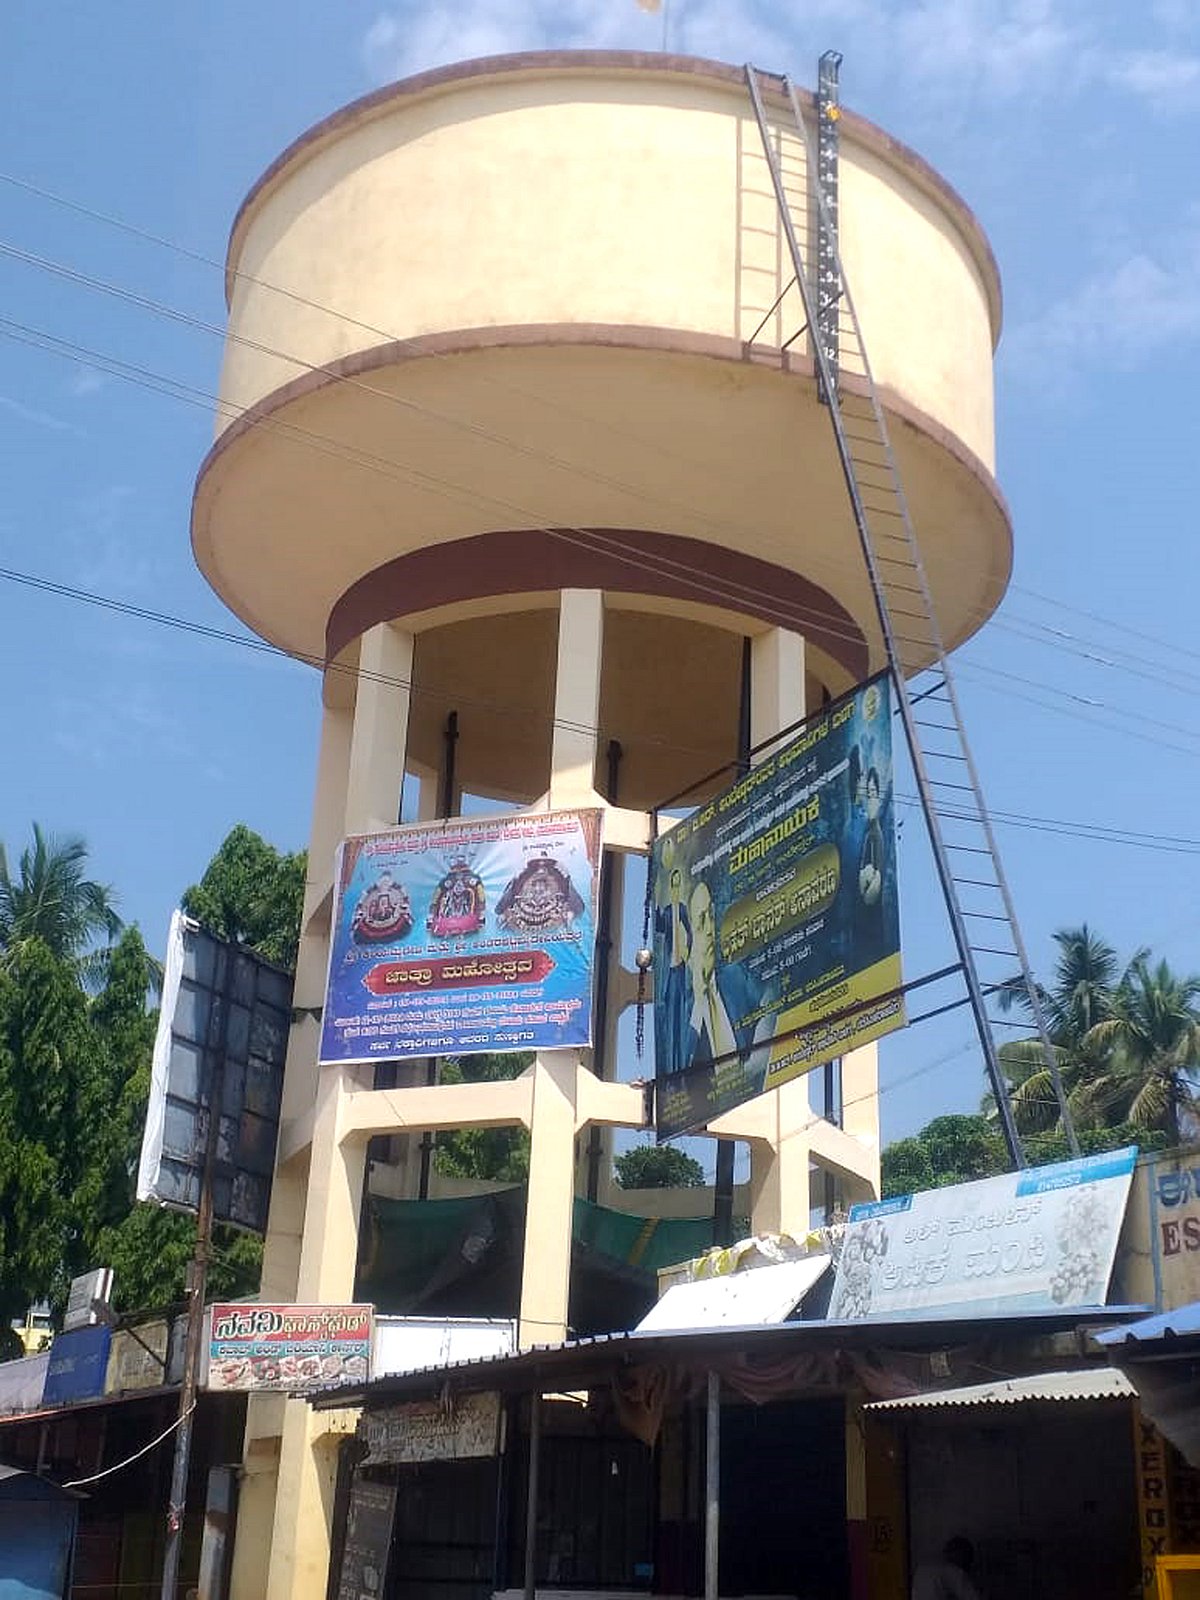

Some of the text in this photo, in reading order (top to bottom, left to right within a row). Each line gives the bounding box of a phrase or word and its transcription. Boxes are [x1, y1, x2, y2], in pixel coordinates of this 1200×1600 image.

[728, 792, 819, 875] ಮಹಾನಾಯಕ
[384, 957, 534, 986] ಜಾತ್ರಾ ಮಹೋತ್ಸವ
[215, 1310, 284, 1340] ನವಮಿ
